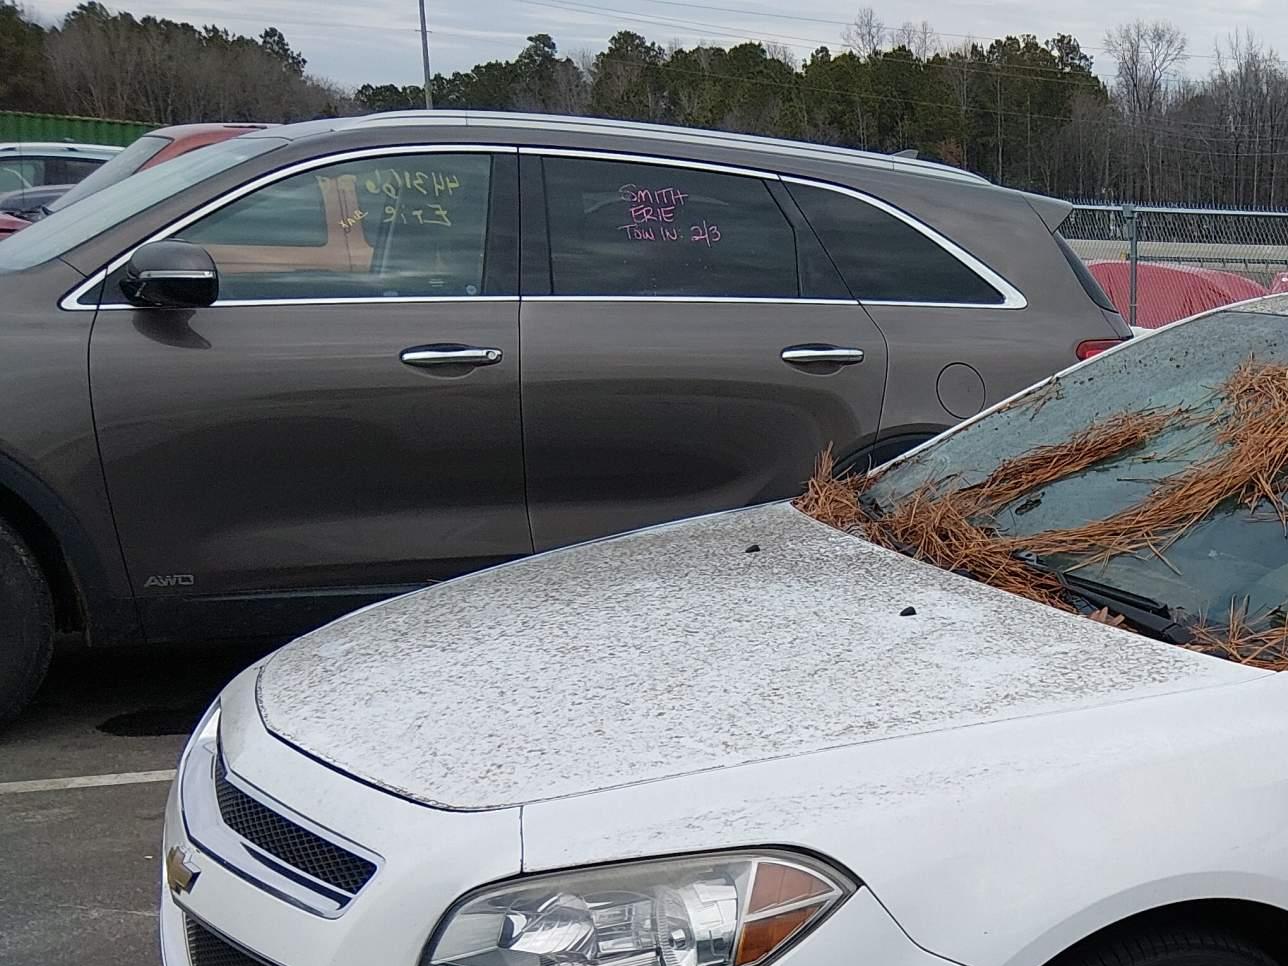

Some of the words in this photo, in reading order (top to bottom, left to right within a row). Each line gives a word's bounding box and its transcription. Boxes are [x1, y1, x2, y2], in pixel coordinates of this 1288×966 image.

[619, 183, 689, 206] SMITH
[629, 204, 676, 223] ERIE
[690, 219, 722, 248] 2/3
[143, 574, 195, 588] AWD
